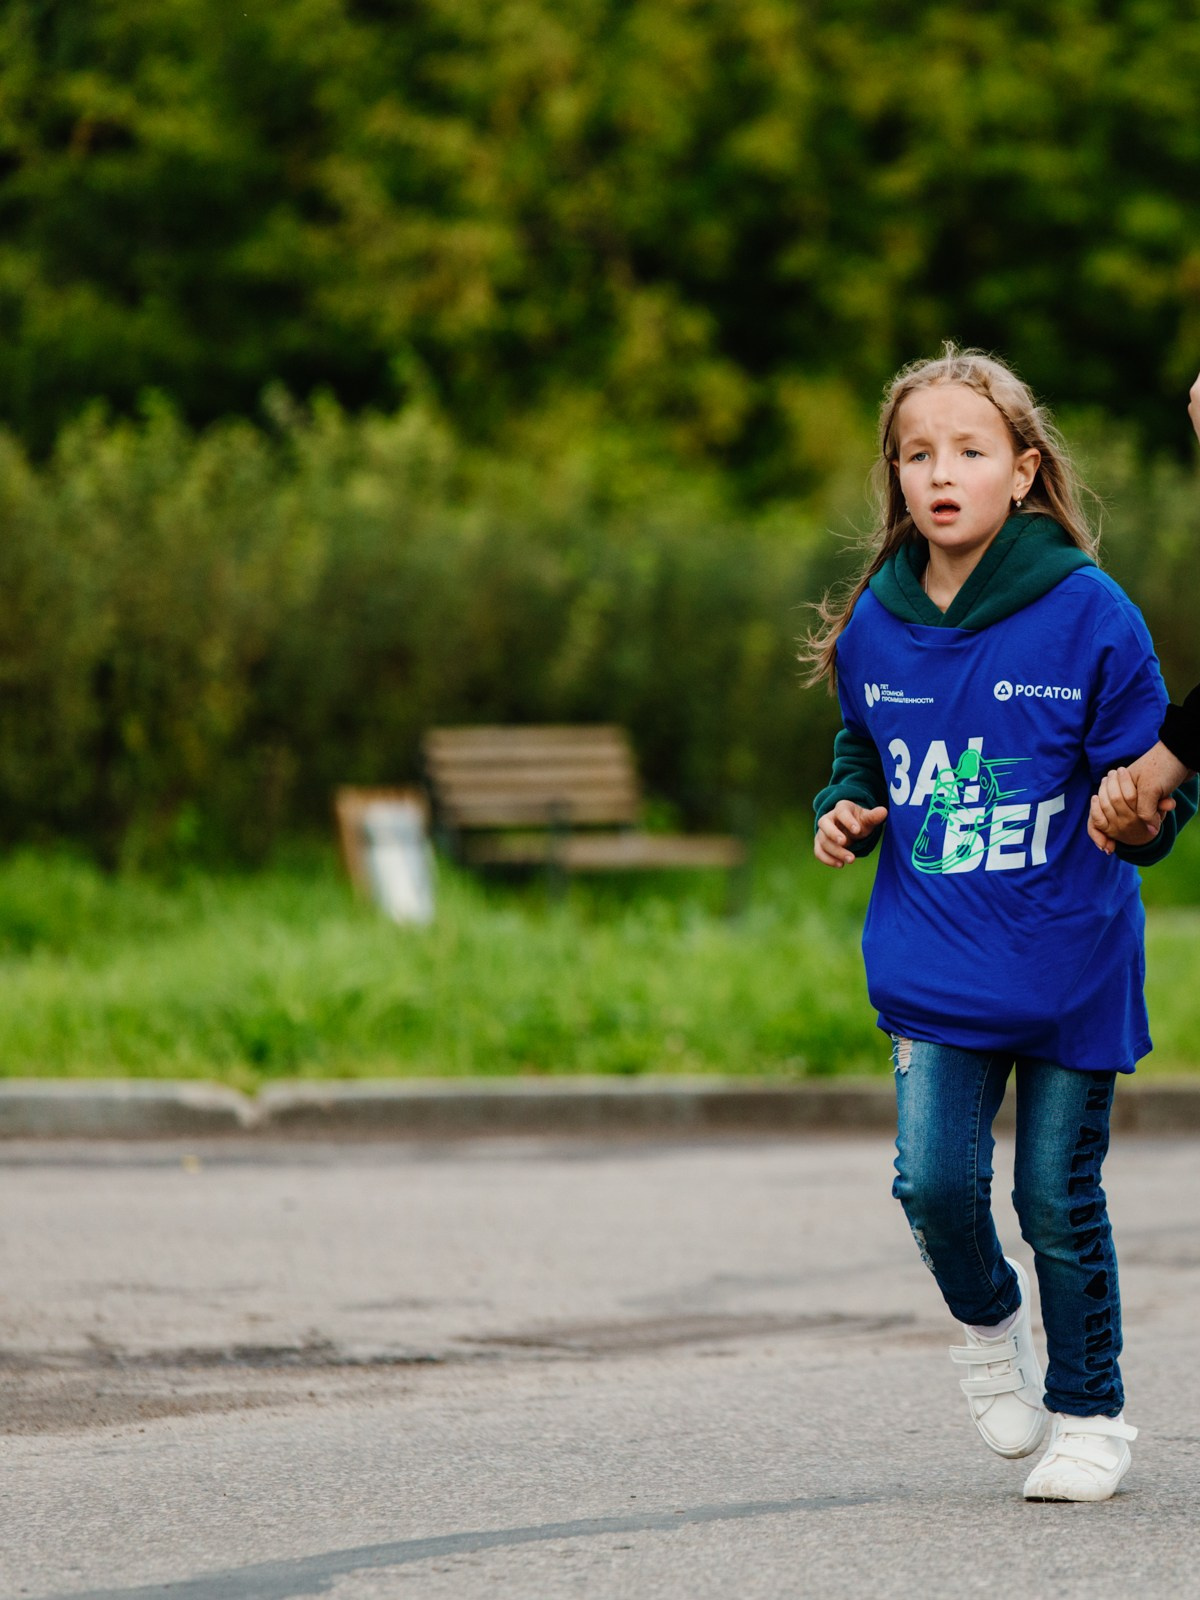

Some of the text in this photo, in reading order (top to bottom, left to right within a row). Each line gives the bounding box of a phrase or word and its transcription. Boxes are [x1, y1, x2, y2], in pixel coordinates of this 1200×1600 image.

[1015, 684, 1082, 700] РОСАТОМ
[942, 793, 1066, 875] БЕГ
[1068, 1124, 1101, 1197] ALL
[1069, 1201, 1104, 1265] DAY
